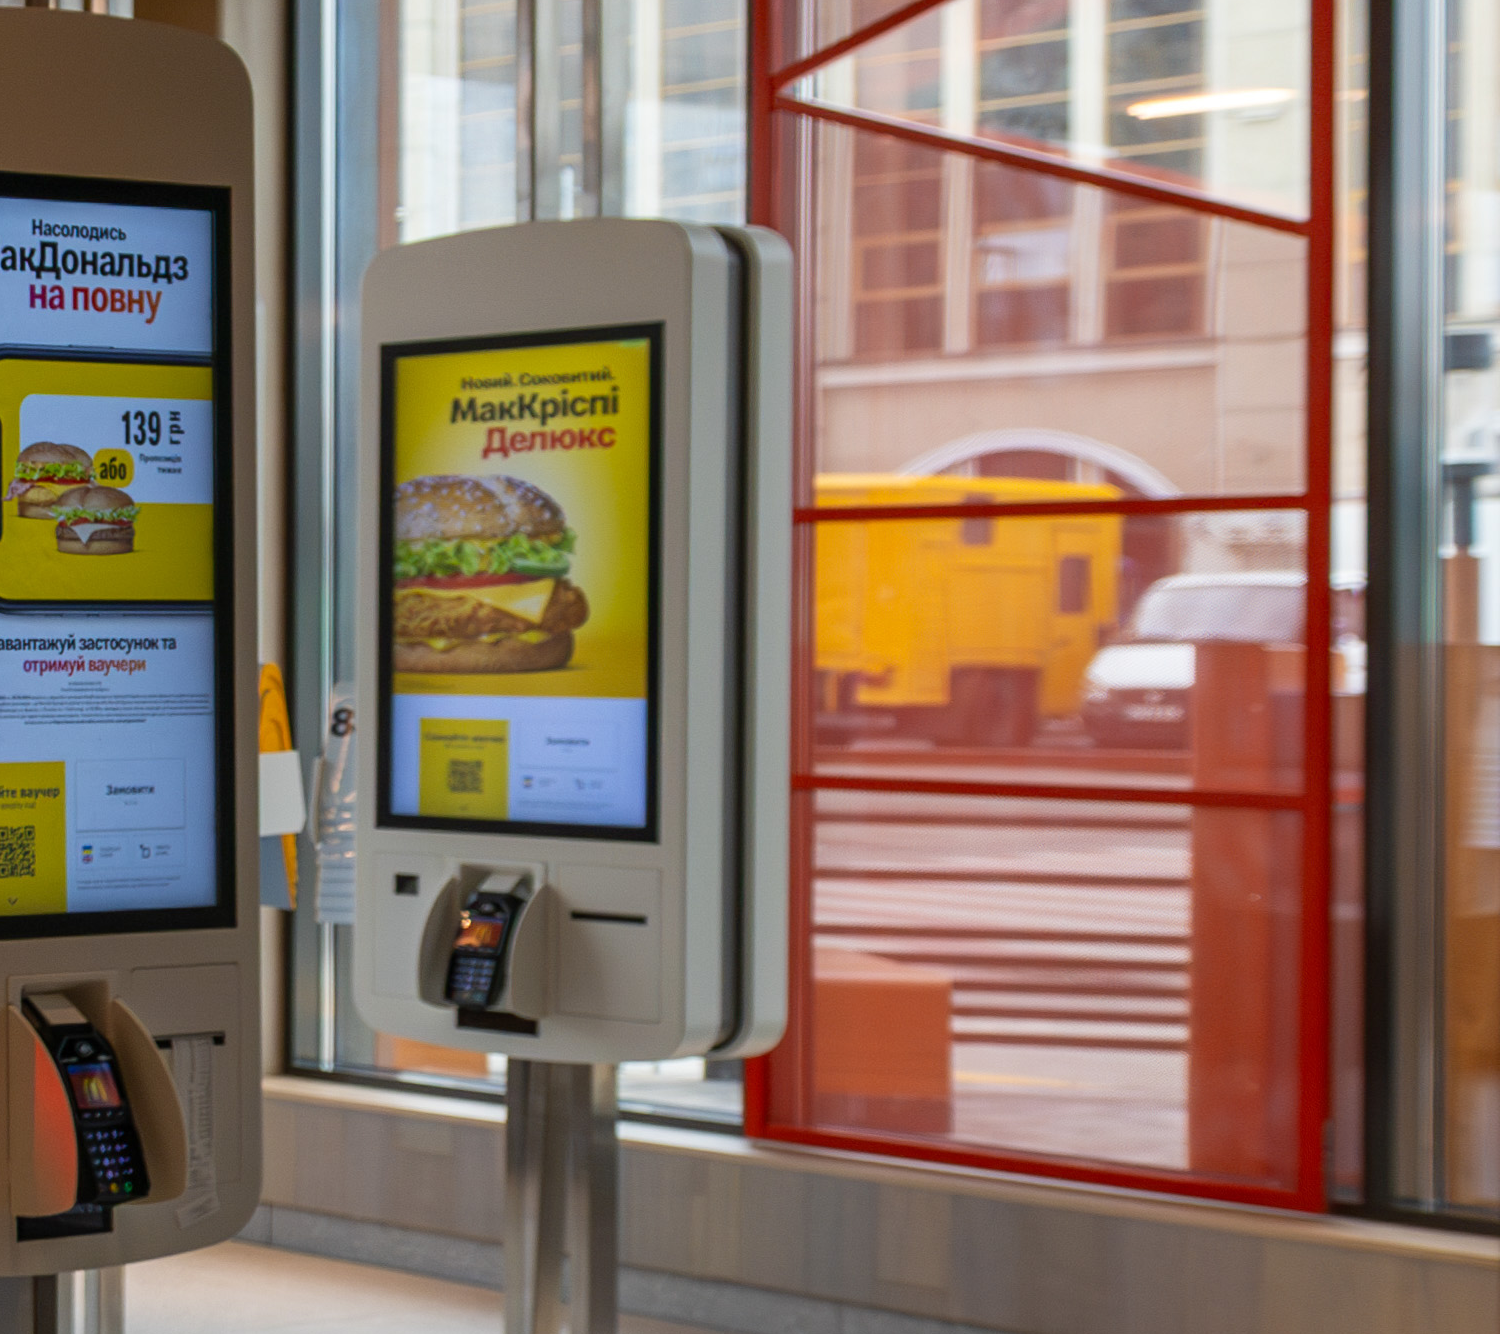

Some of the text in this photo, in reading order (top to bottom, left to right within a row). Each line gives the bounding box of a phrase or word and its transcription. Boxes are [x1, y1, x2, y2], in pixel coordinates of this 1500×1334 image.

[31, 218, 127, 242] Насолодись
[29, 284, 162, 325] на повну
[451, 385, 620, 426] МакКріспі
[121, 410, 162, 446] 139
[482, 426, 617, 460] Делюкс
[99, 457, 127, 480] або
[79, 635, 159, 658] застосунок
[161, 637, 177, 651] та
[22, 655, 147, 677] отримуй ваучери
